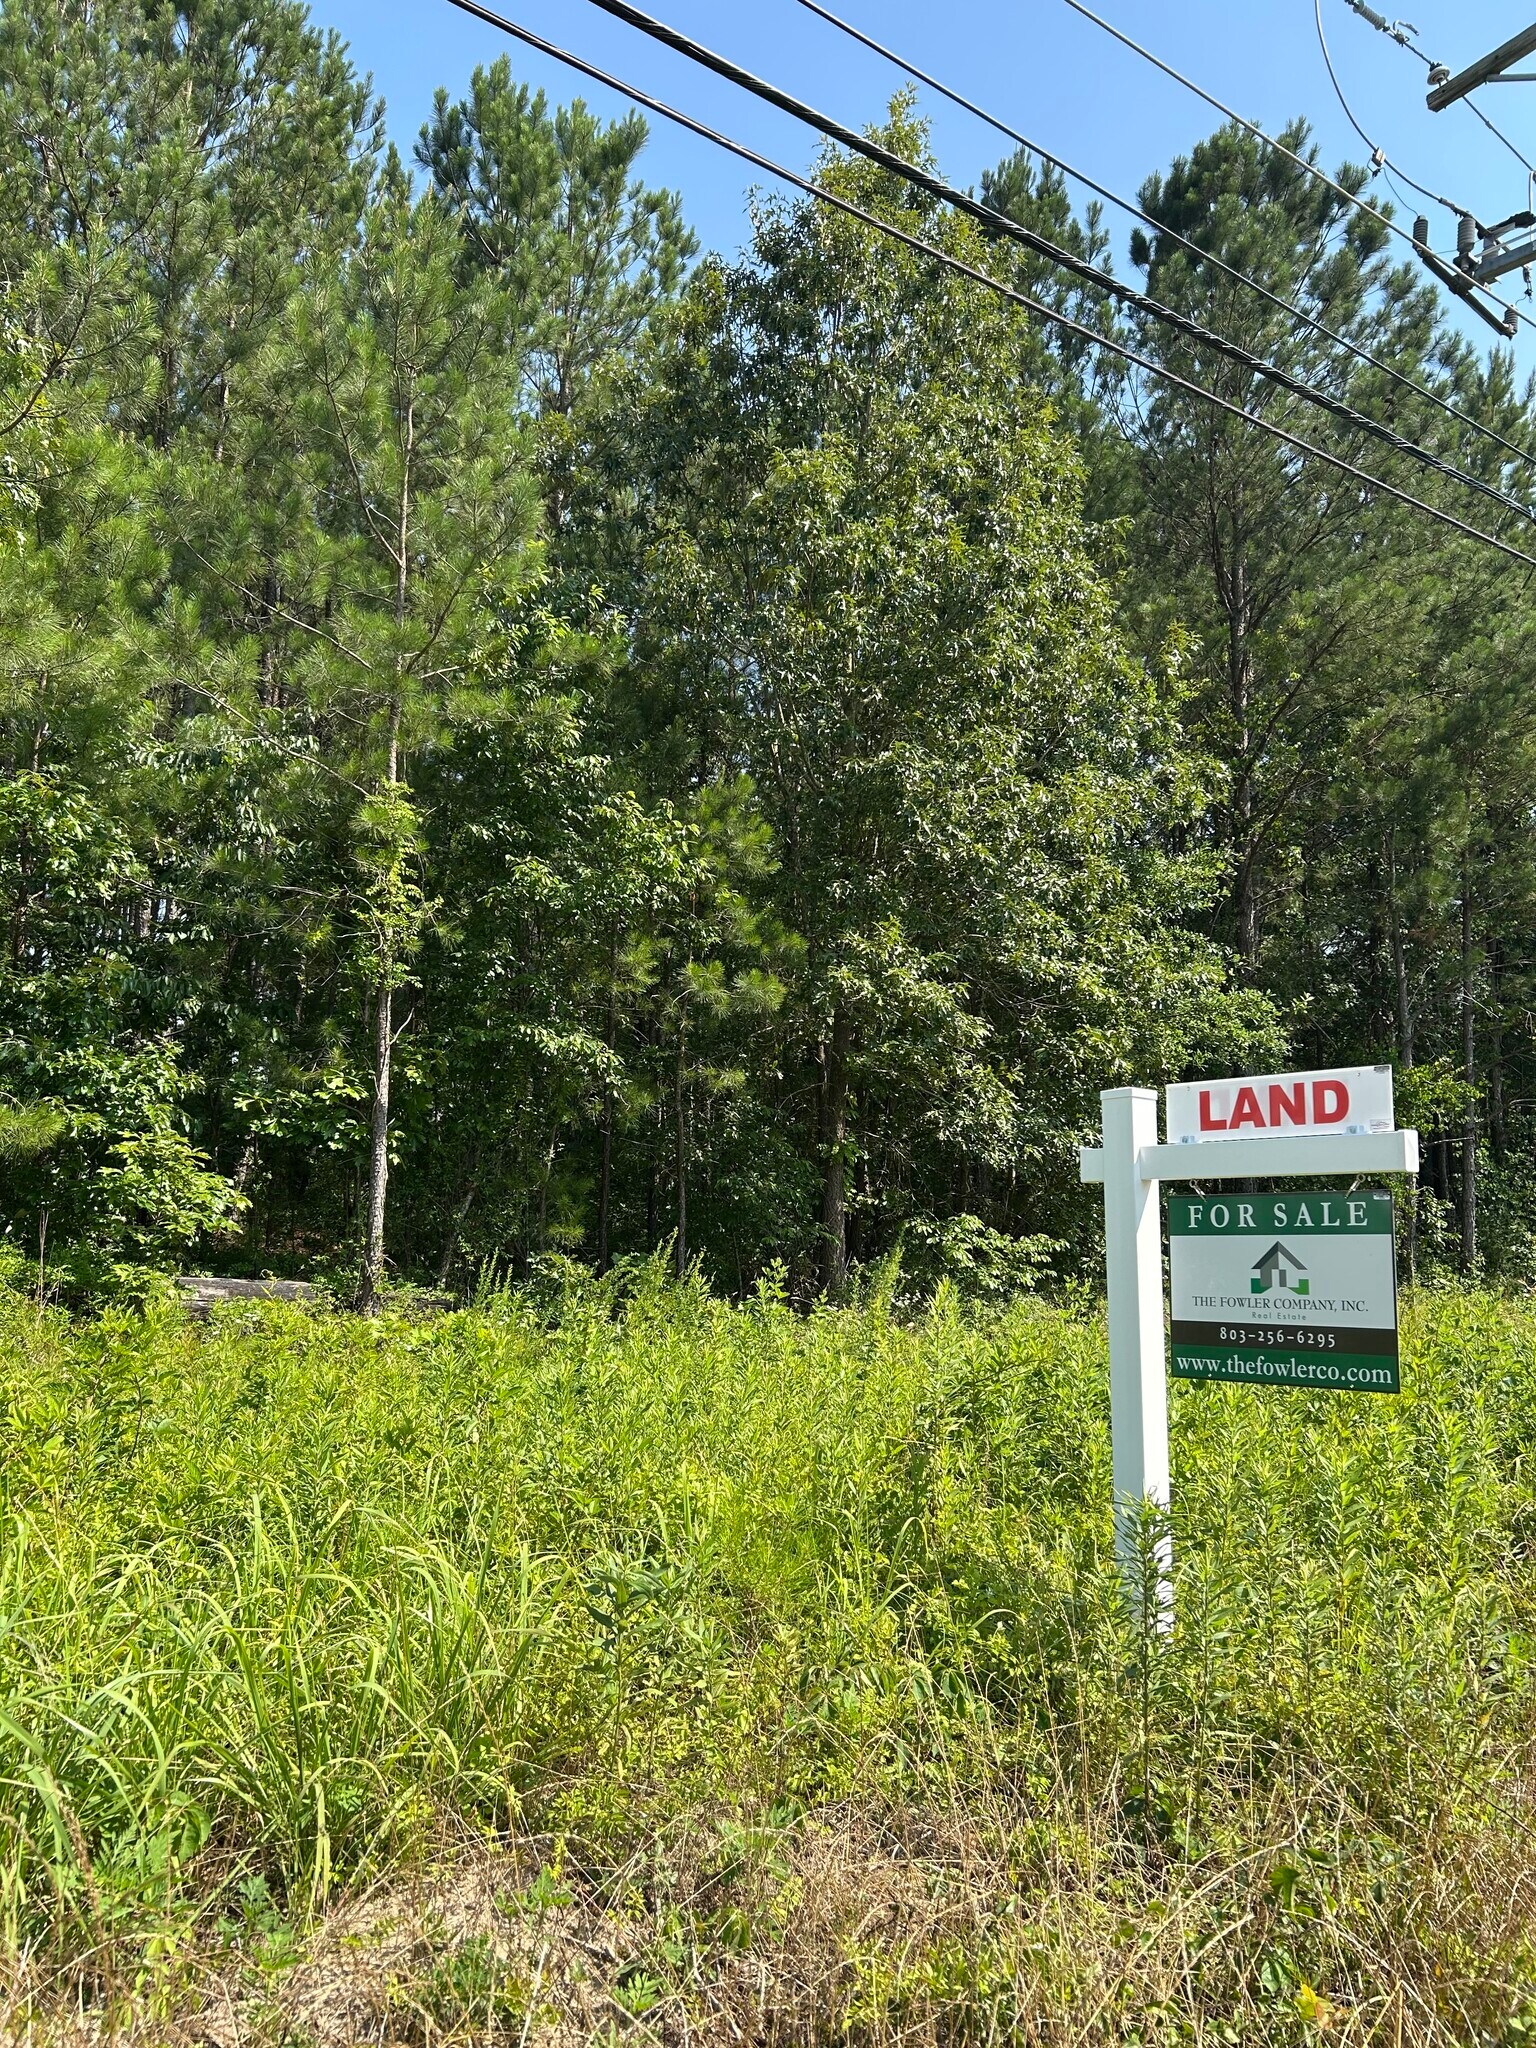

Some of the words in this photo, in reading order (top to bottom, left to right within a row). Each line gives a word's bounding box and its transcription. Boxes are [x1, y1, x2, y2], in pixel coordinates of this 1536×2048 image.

[1199, 1079, 1349, 1131] LAND
[1188, 1204, 1256, 1228] FOR
[1273, 1201, 1368, 1227] SALE
[1192, 1296, 1216, 1307] THE
[1220, 1297, 1270, 1309] FOWLER
[1273, 1298, 1337, 1313] COMPANY,
[1341, 1301, 1369, 1312] INC.
[1252, 1312, 1272, 1320] Real
[1277, 1313, 1307, 1321] Estate
[1219, 1327, 1336, 1348] 803-256-6295
[1176, 1354, 1393, 1384] www.thefowlerco.com
